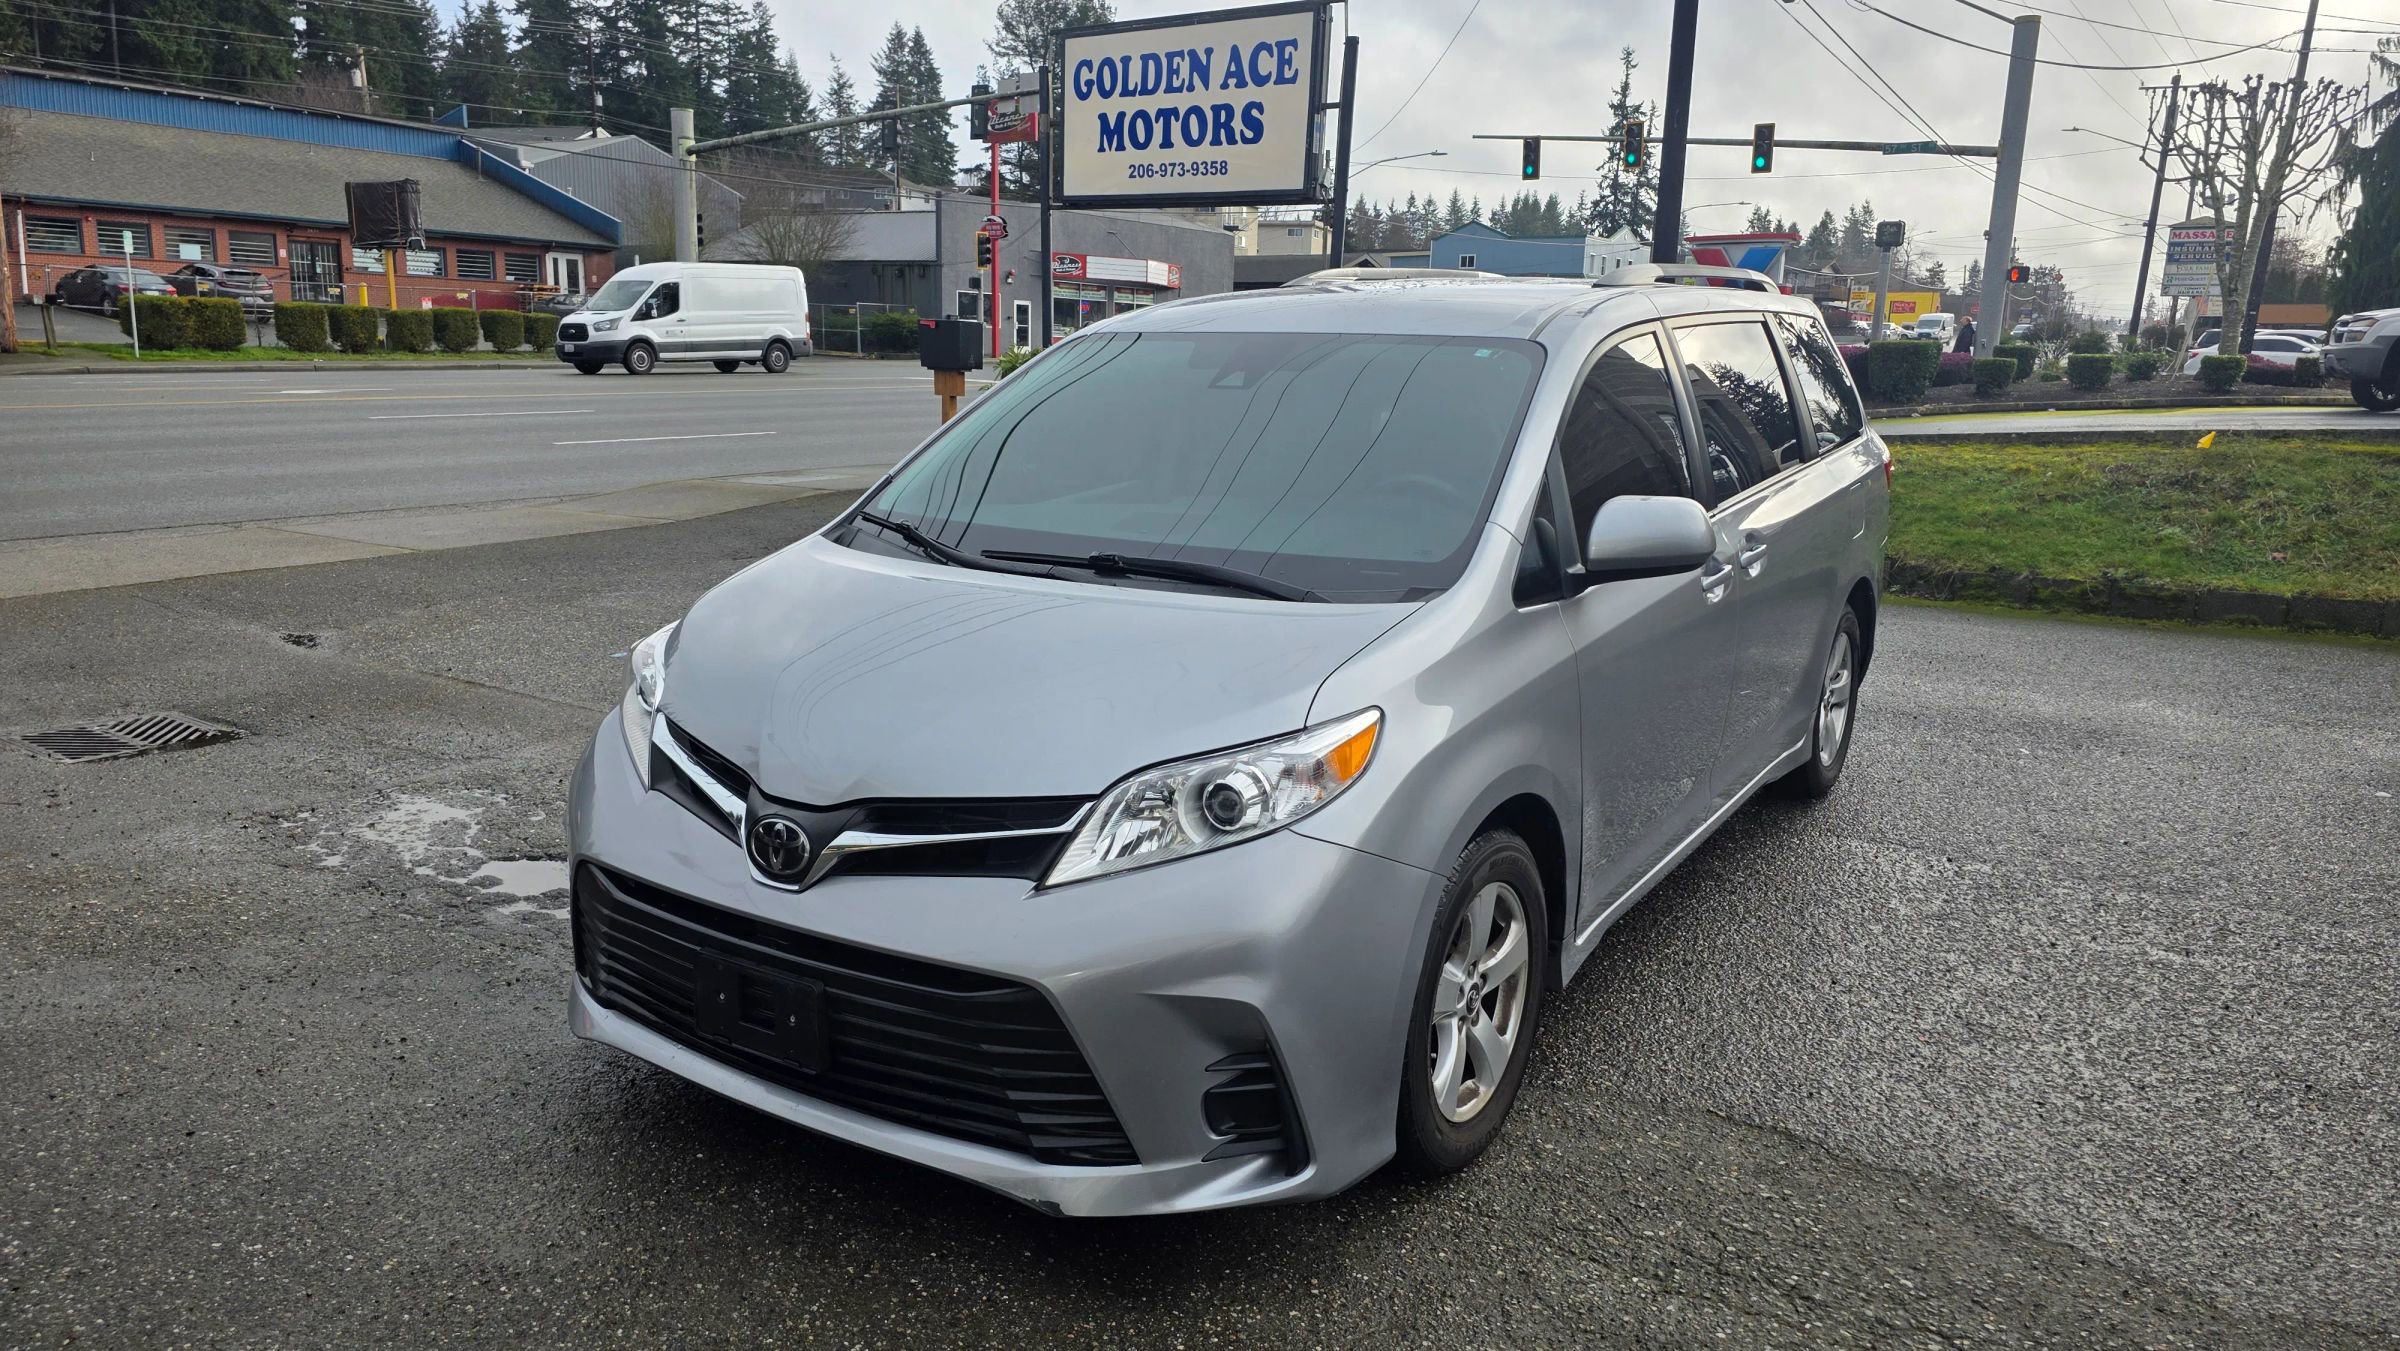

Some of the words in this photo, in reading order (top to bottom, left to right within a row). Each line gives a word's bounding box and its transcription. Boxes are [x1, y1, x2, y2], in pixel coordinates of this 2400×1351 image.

[1073, 46, 1214, 101] GOLDEN
[1219, 38, 1299, 90] ACE
[1097, 100, 1265, 153] MOTORS
[1128, 160, 1229, 179] 206-973-9358
[2172, 231, 2234, 239] MASSAE
